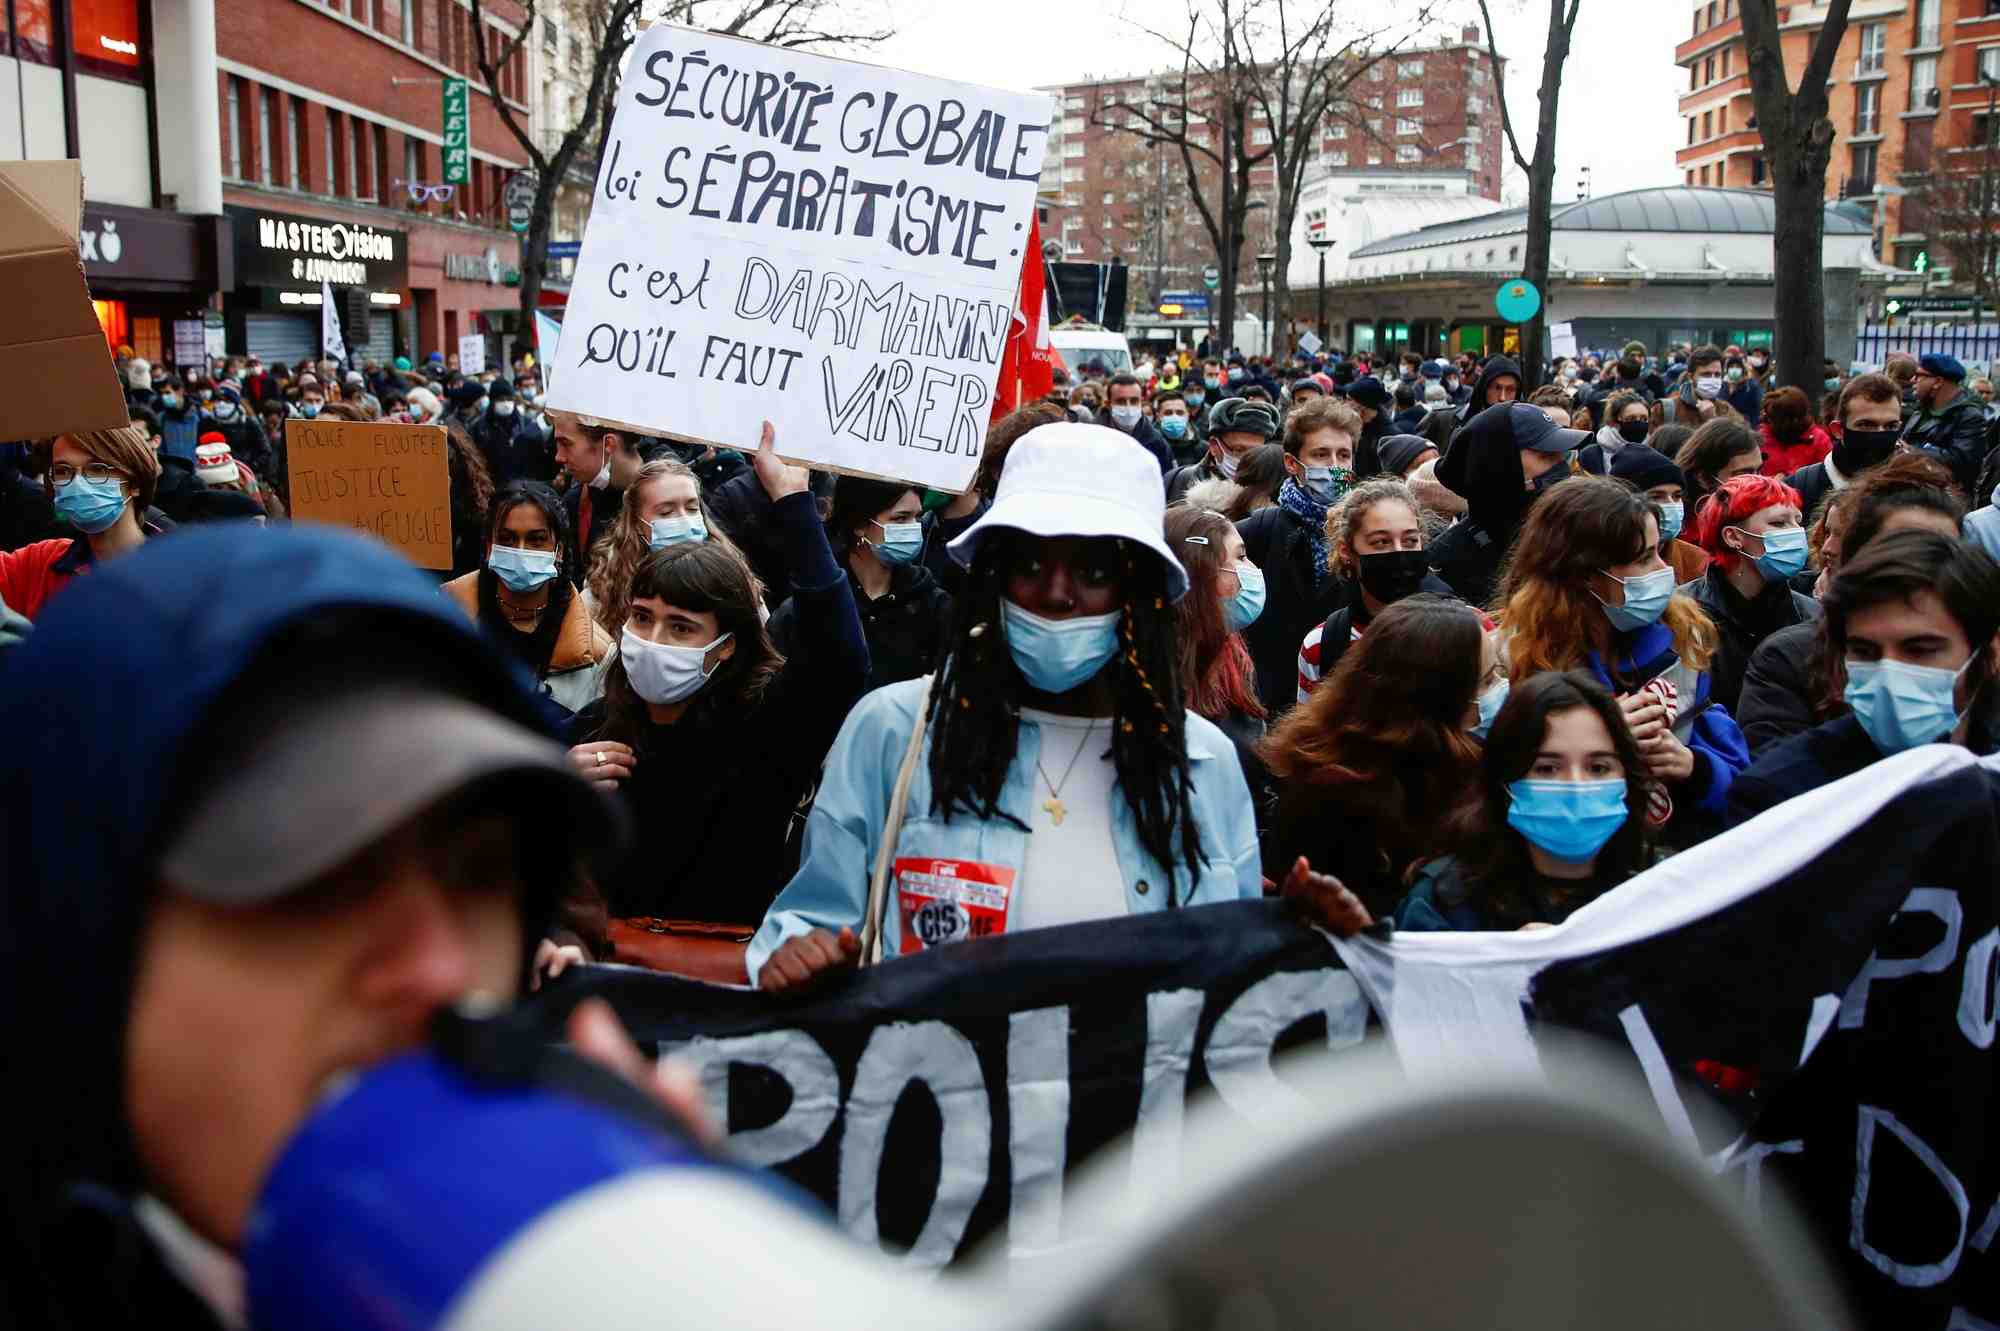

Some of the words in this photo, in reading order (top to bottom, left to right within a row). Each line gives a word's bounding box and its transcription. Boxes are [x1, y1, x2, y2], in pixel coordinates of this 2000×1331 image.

[445, 82, 465, 180] FLEURS
[839, 91, 1050, 183] GLOBALE
[604, 140, 642, 201] loi
[608, 258, 711, 310] c'est
[699, 334, 803, 392] FAUT
[296, 465, 406, 505] JUSTICE
